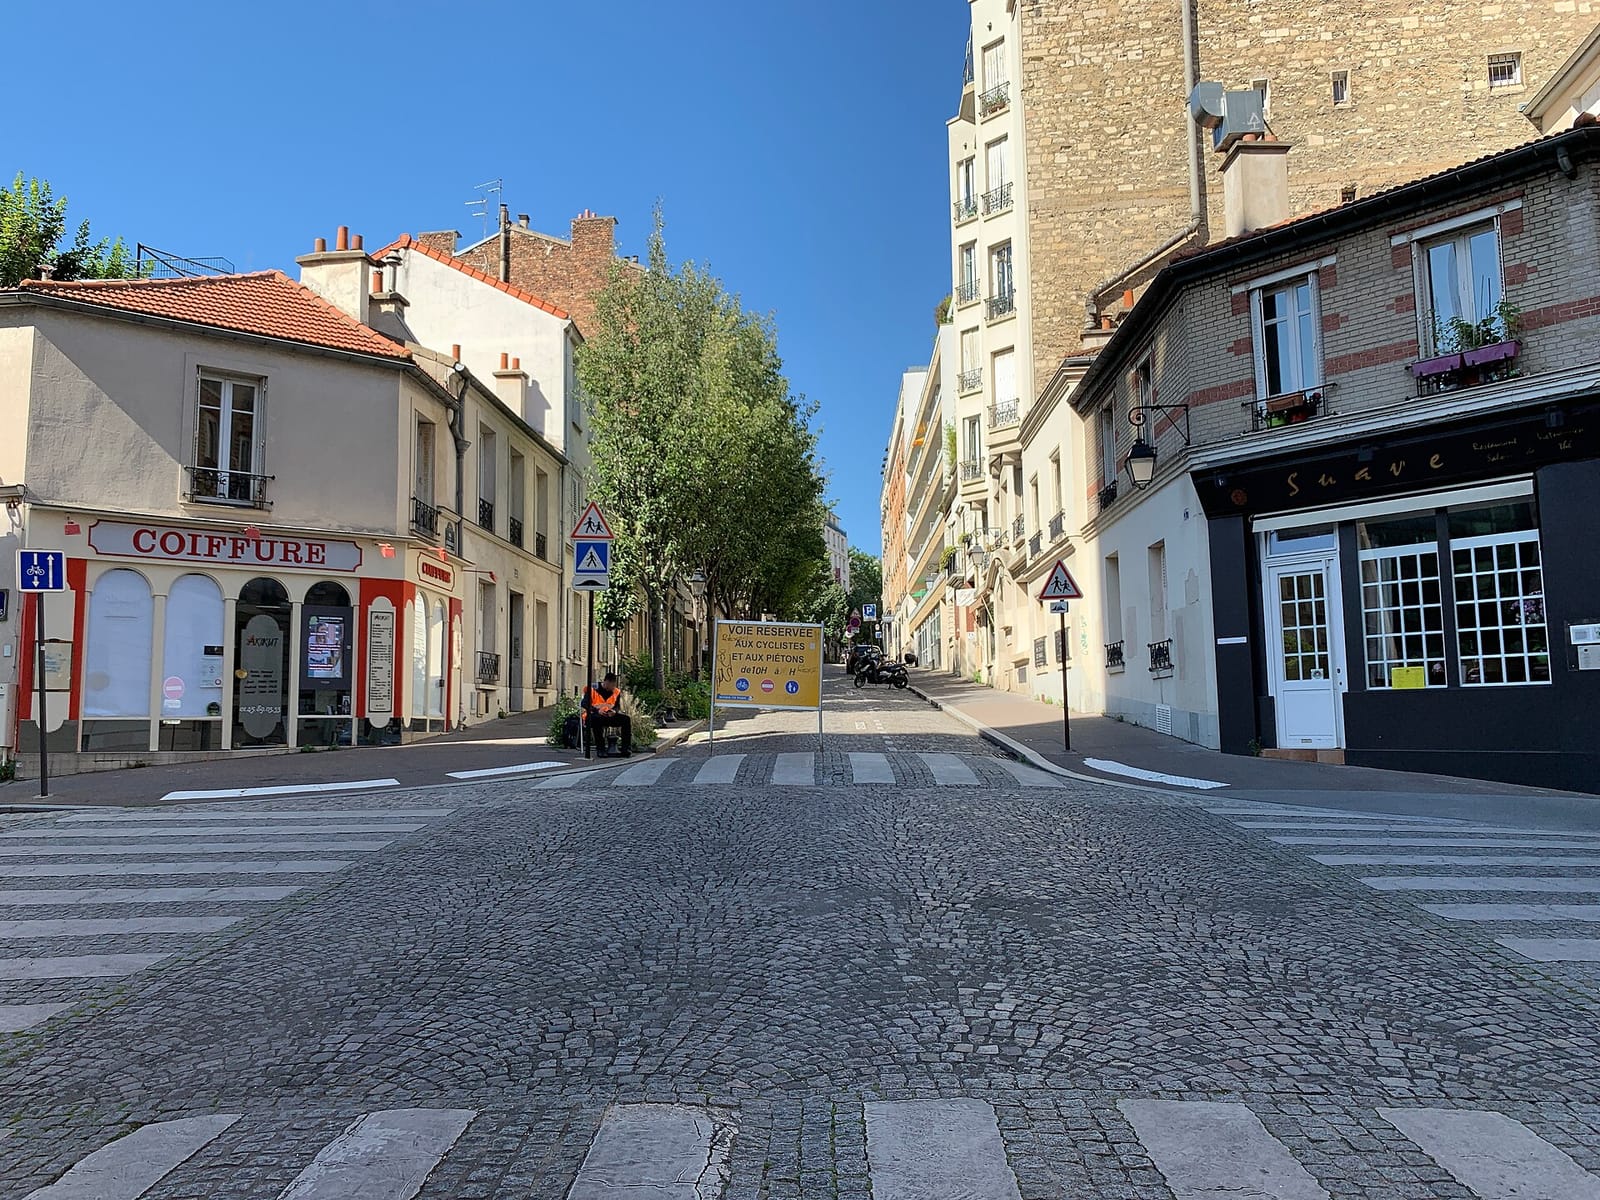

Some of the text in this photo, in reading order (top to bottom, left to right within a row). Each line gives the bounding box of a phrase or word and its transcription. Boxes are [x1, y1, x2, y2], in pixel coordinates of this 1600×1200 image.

[1287, 453, 1444, 497] Suave
[132, 528, 326, 565] COIFFURE
[728, 625, 753, 636] VOIE
[735, 640, 805, 650] AUX CYCLISTES
[732, 652, 804, 664] ET AUX PIÉTONS
